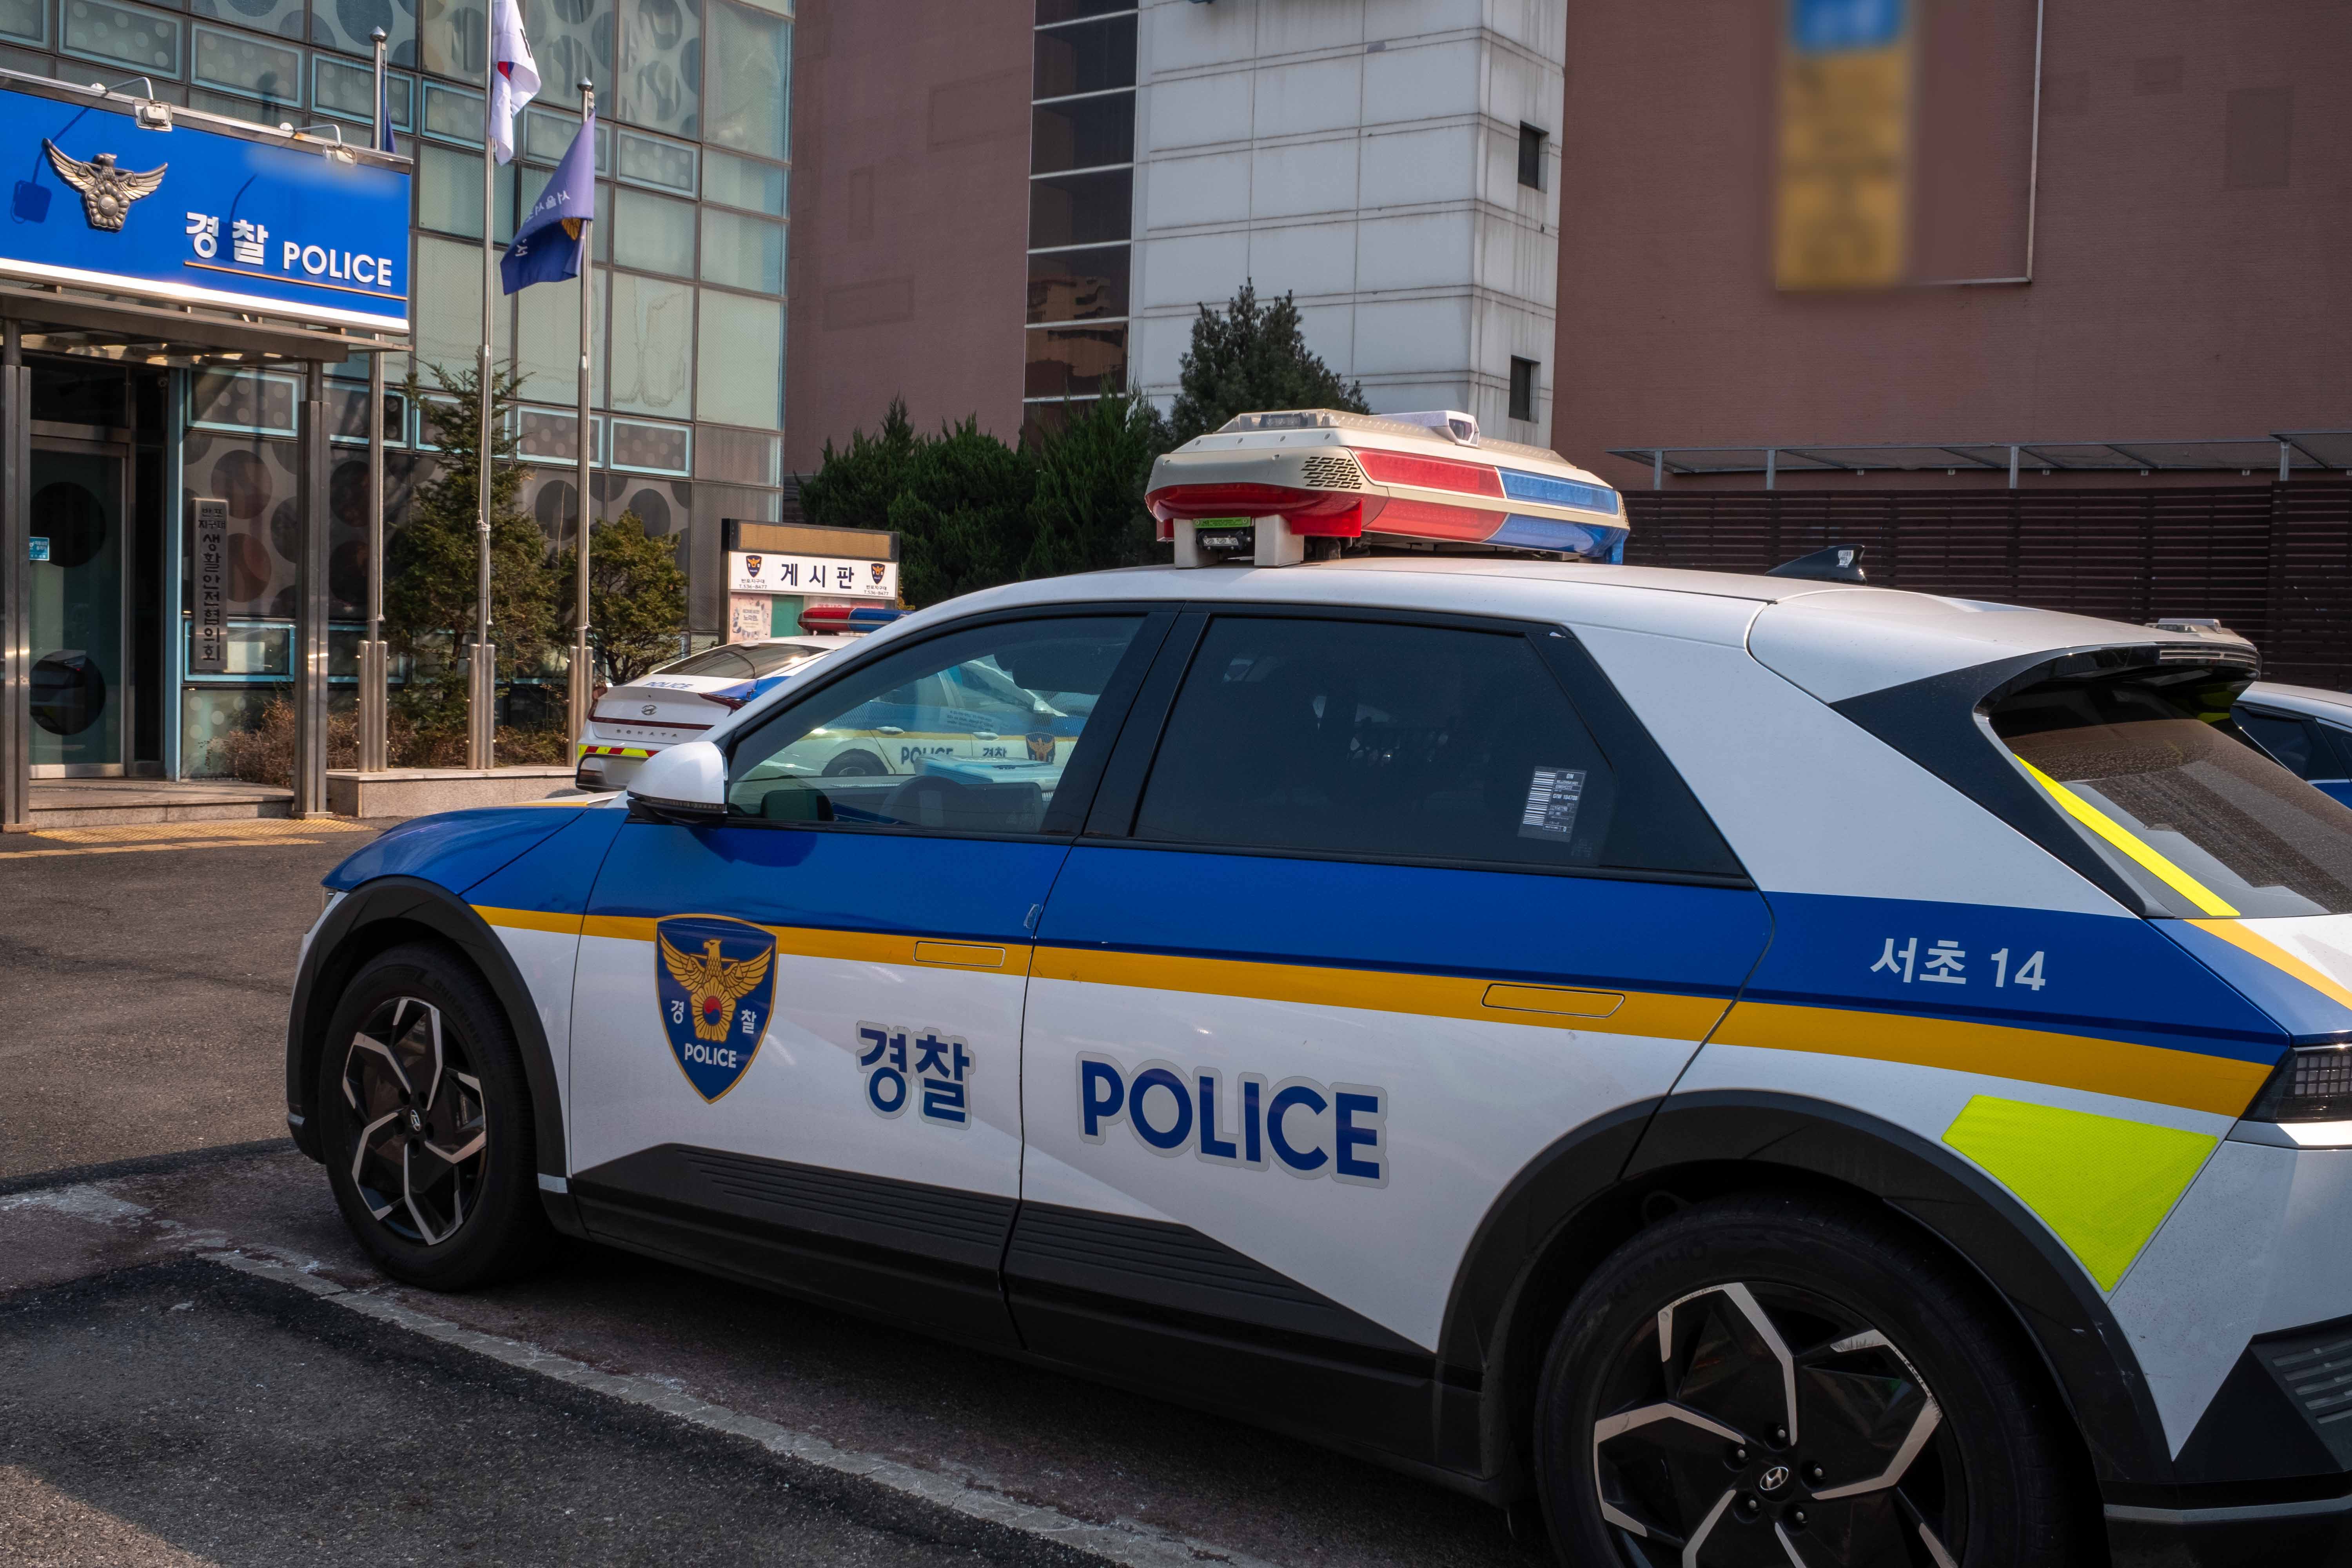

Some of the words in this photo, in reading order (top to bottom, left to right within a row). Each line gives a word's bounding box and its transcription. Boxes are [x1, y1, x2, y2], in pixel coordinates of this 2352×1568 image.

[185, 212, 269, 265] 경찰
[283, 241, 391, 287] POLICE
[198, 520, 226, 529] 지구대
[202, 508, 223, 517] 반포
[780, 563, 855, 589] 게시판
[203, 534, 221, 661] 생활안전협의회
[616, 729, 677, 738] SONATA
[1869, 937, 1967, 984] 서초
[1991, 947, 2046, 991] 14
[671, 1000, 685, 1024] 경
[741, 1009, 757, 1035] 찰
[684, 1042, 737, 1069] POLICE
[860, 1027, 970, 1123] 경찰
[1082, 1060, 1380, 1180] POLICE
